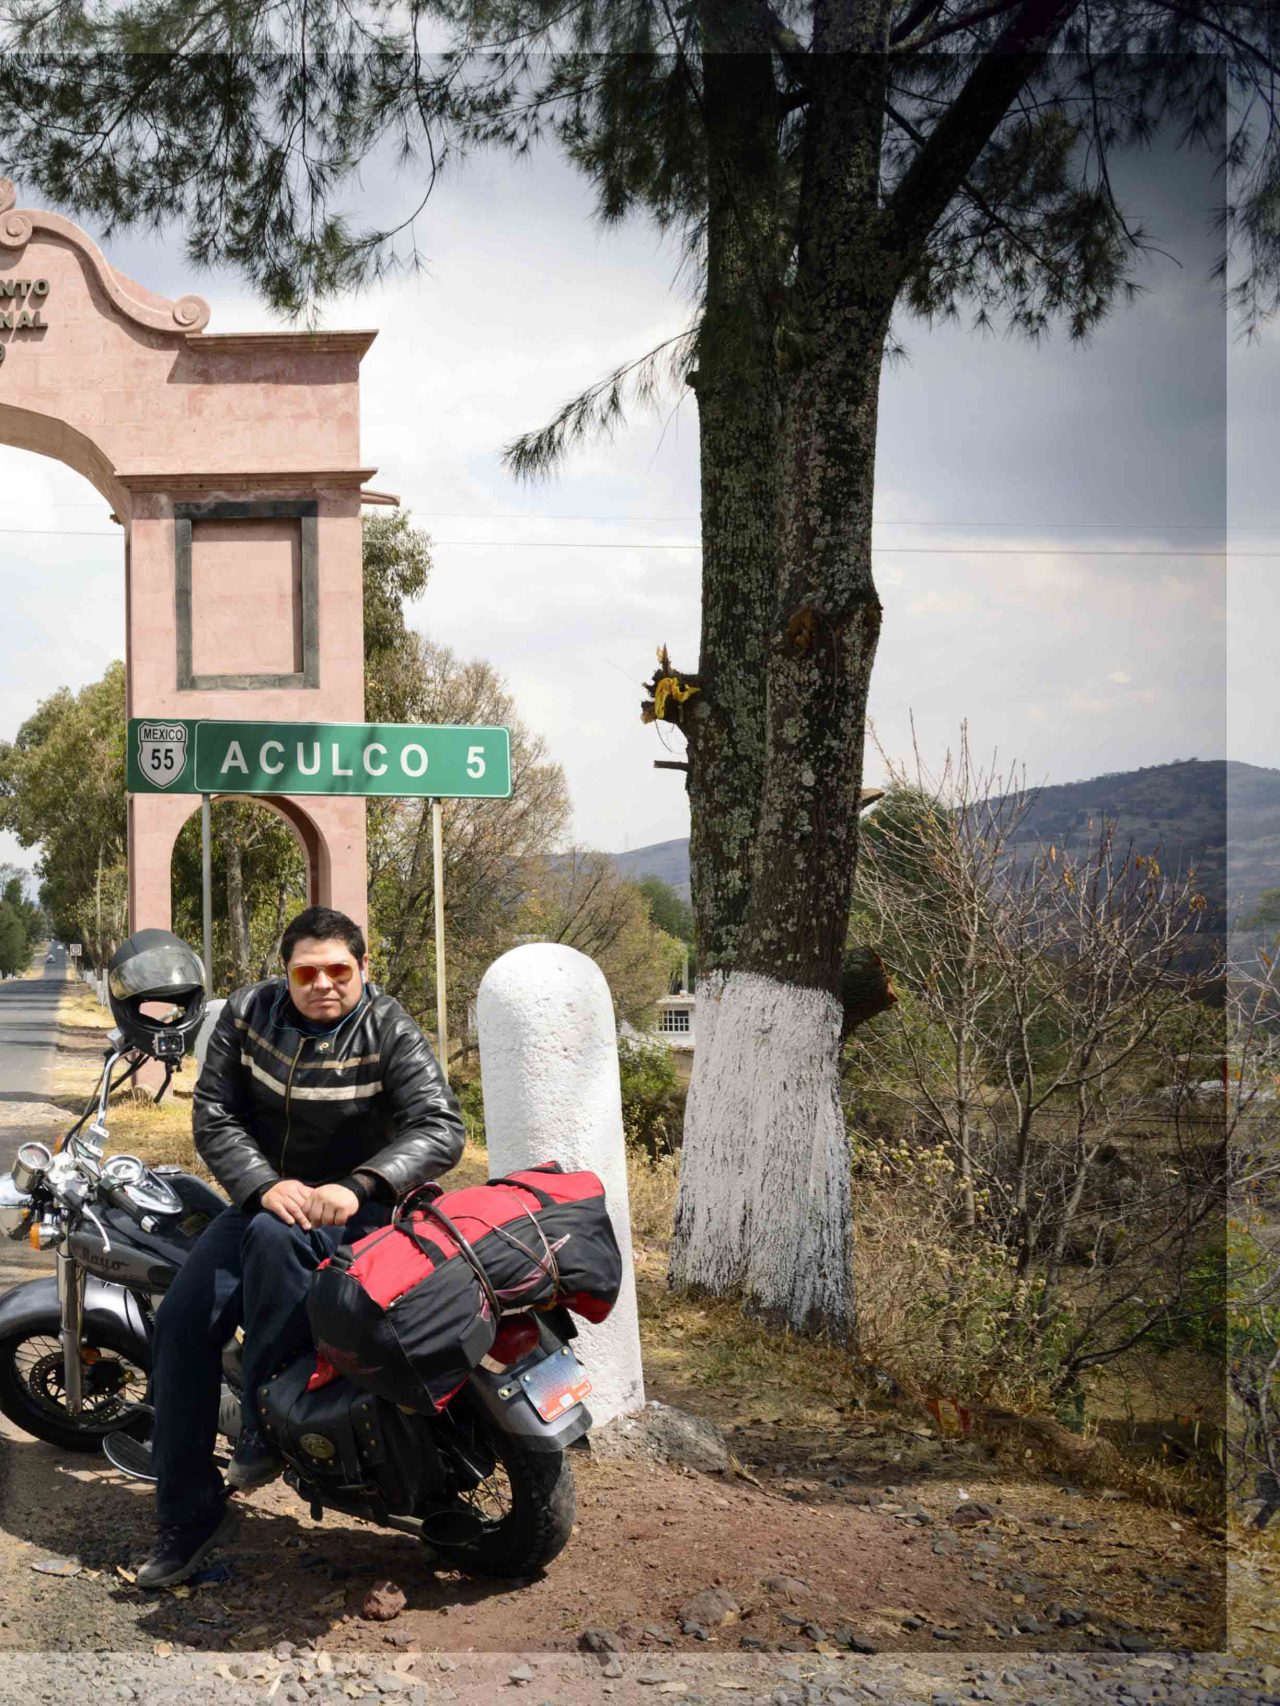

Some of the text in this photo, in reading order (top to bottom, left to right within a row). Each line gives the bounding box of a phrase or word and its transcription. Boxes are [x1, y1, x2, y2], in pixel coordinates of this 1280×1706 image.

[143, 728, 183, 741] MEXICO
[151, 748, 174, 771] 55
[220, 740, 486, 779] ACULCO 5
